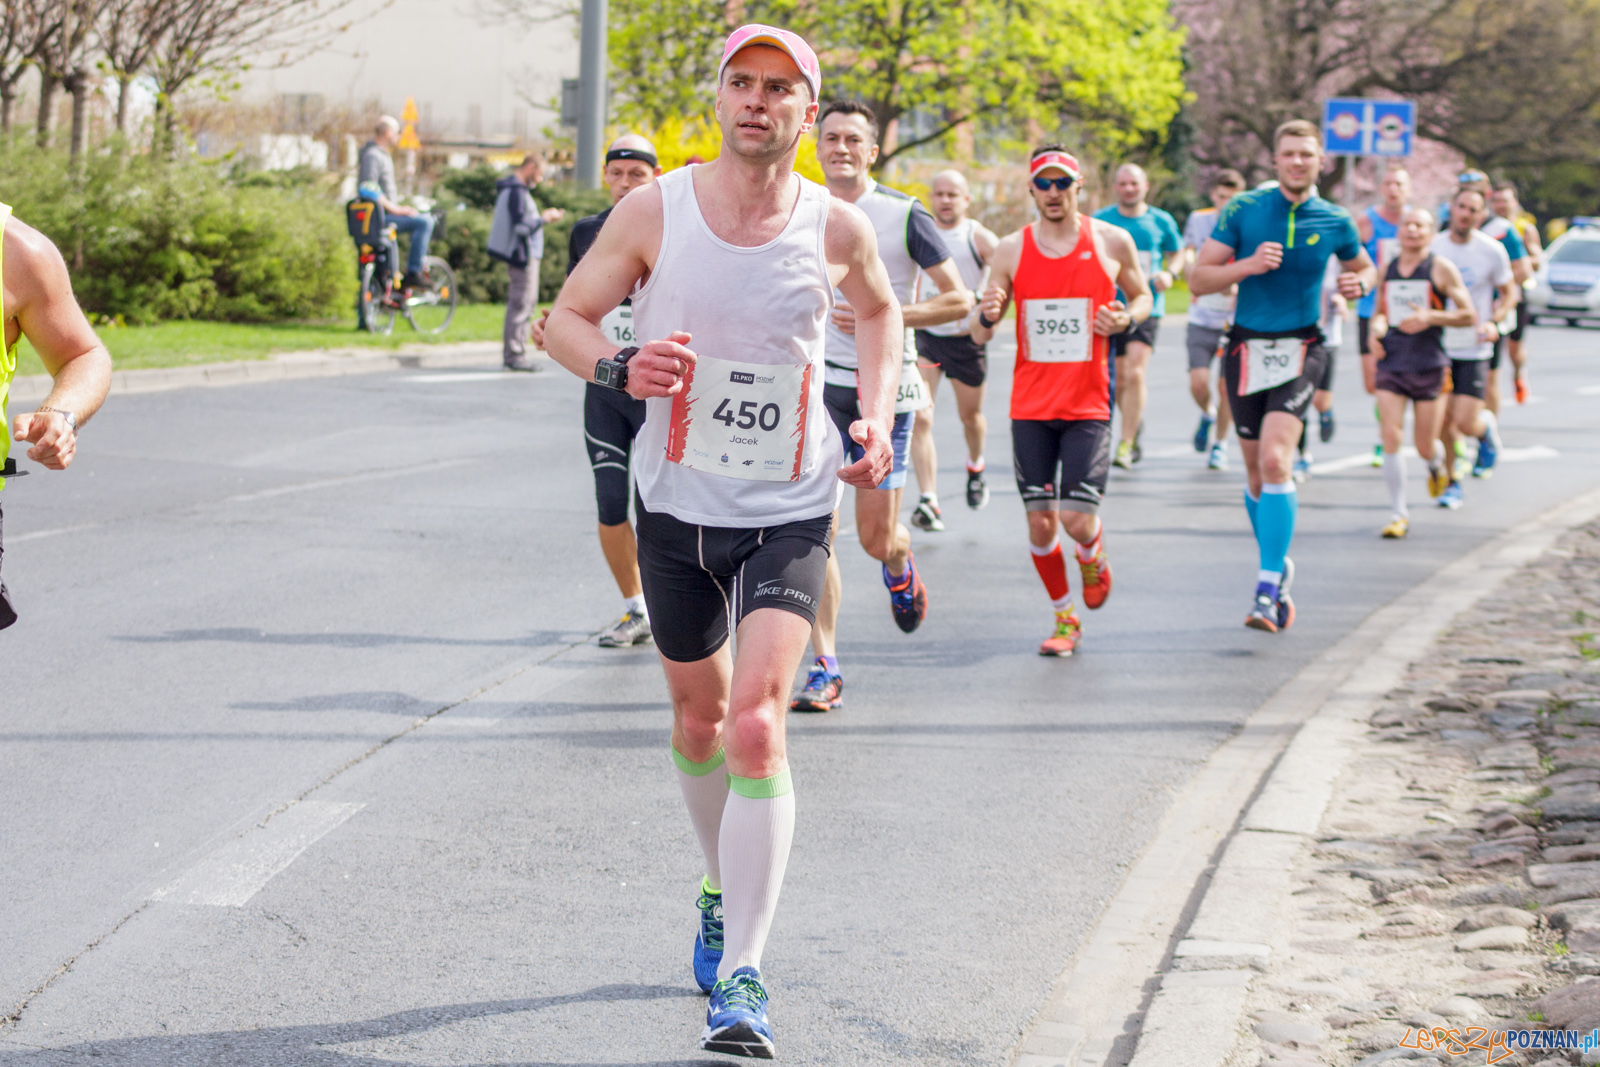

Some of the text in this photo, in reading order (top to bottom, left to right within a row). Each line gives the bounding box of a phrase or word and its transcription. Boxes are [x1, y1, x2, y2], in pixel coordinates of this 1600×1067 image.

[1035, 318, 1080, 335] 3963
[712, 397, 781, 432] 450
[729, 435, 759, 446] Jacek
[753, 586, 782, 599] NIKE
[783, 588, 812, 603] PRO
